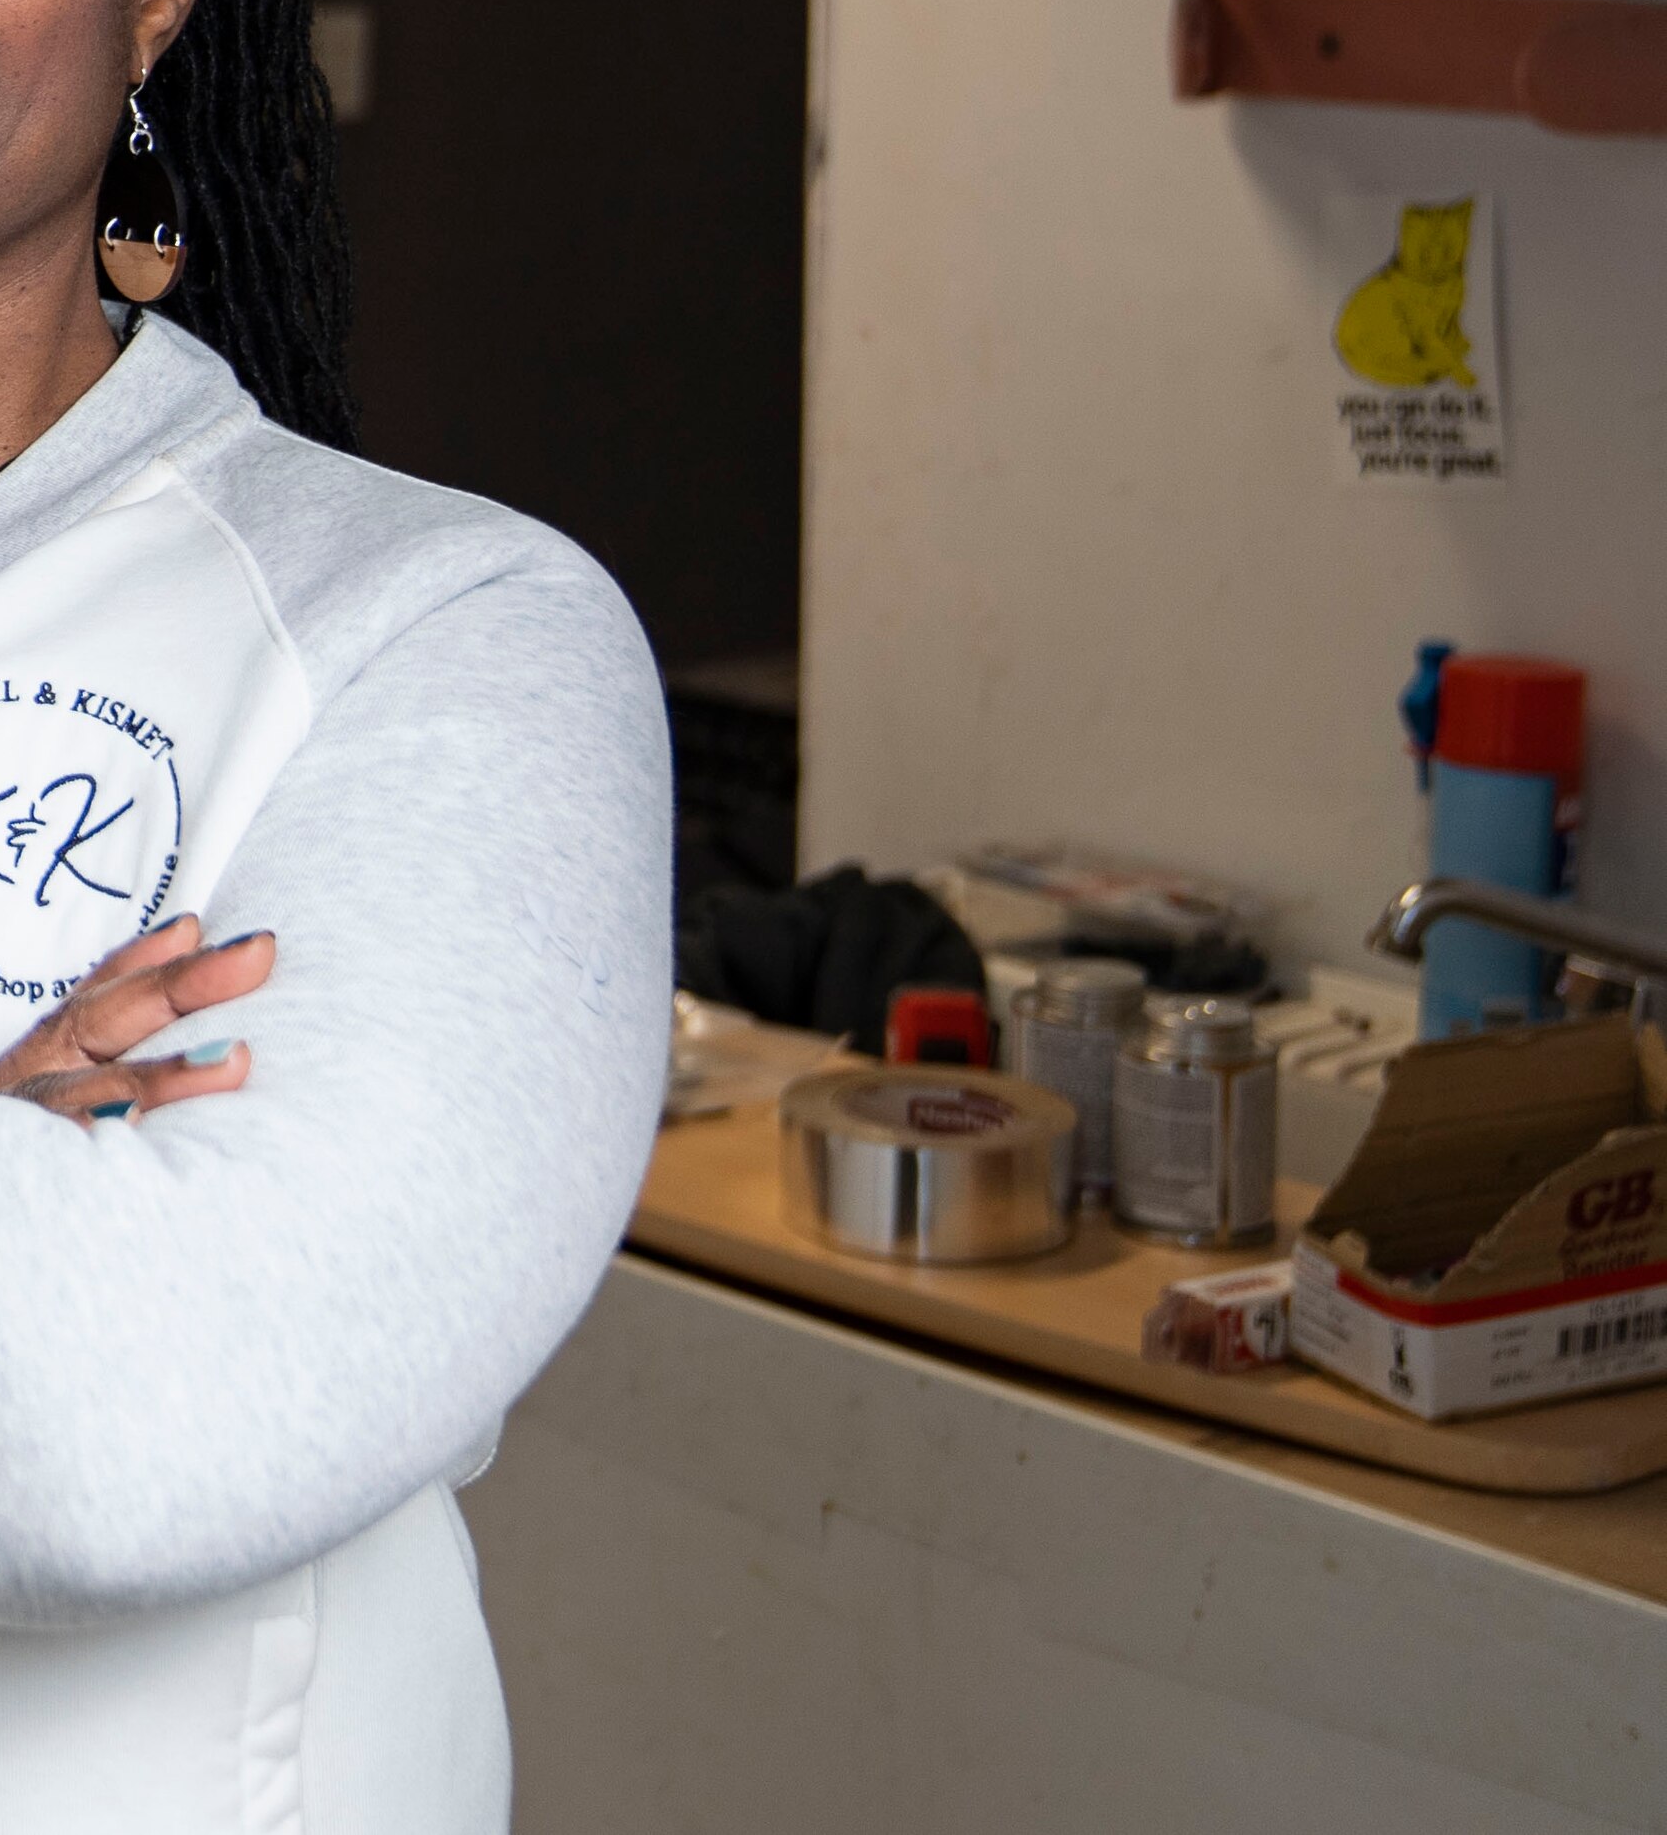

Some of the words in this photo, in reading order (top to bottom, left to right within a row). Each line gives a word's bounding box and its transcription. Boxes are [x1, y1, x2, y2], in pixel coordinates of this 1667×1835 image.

[33, 682, 57, 705] &
[70, 688, 174, 760] KISMET
[1568, 1167, 1655, 1231] GB
